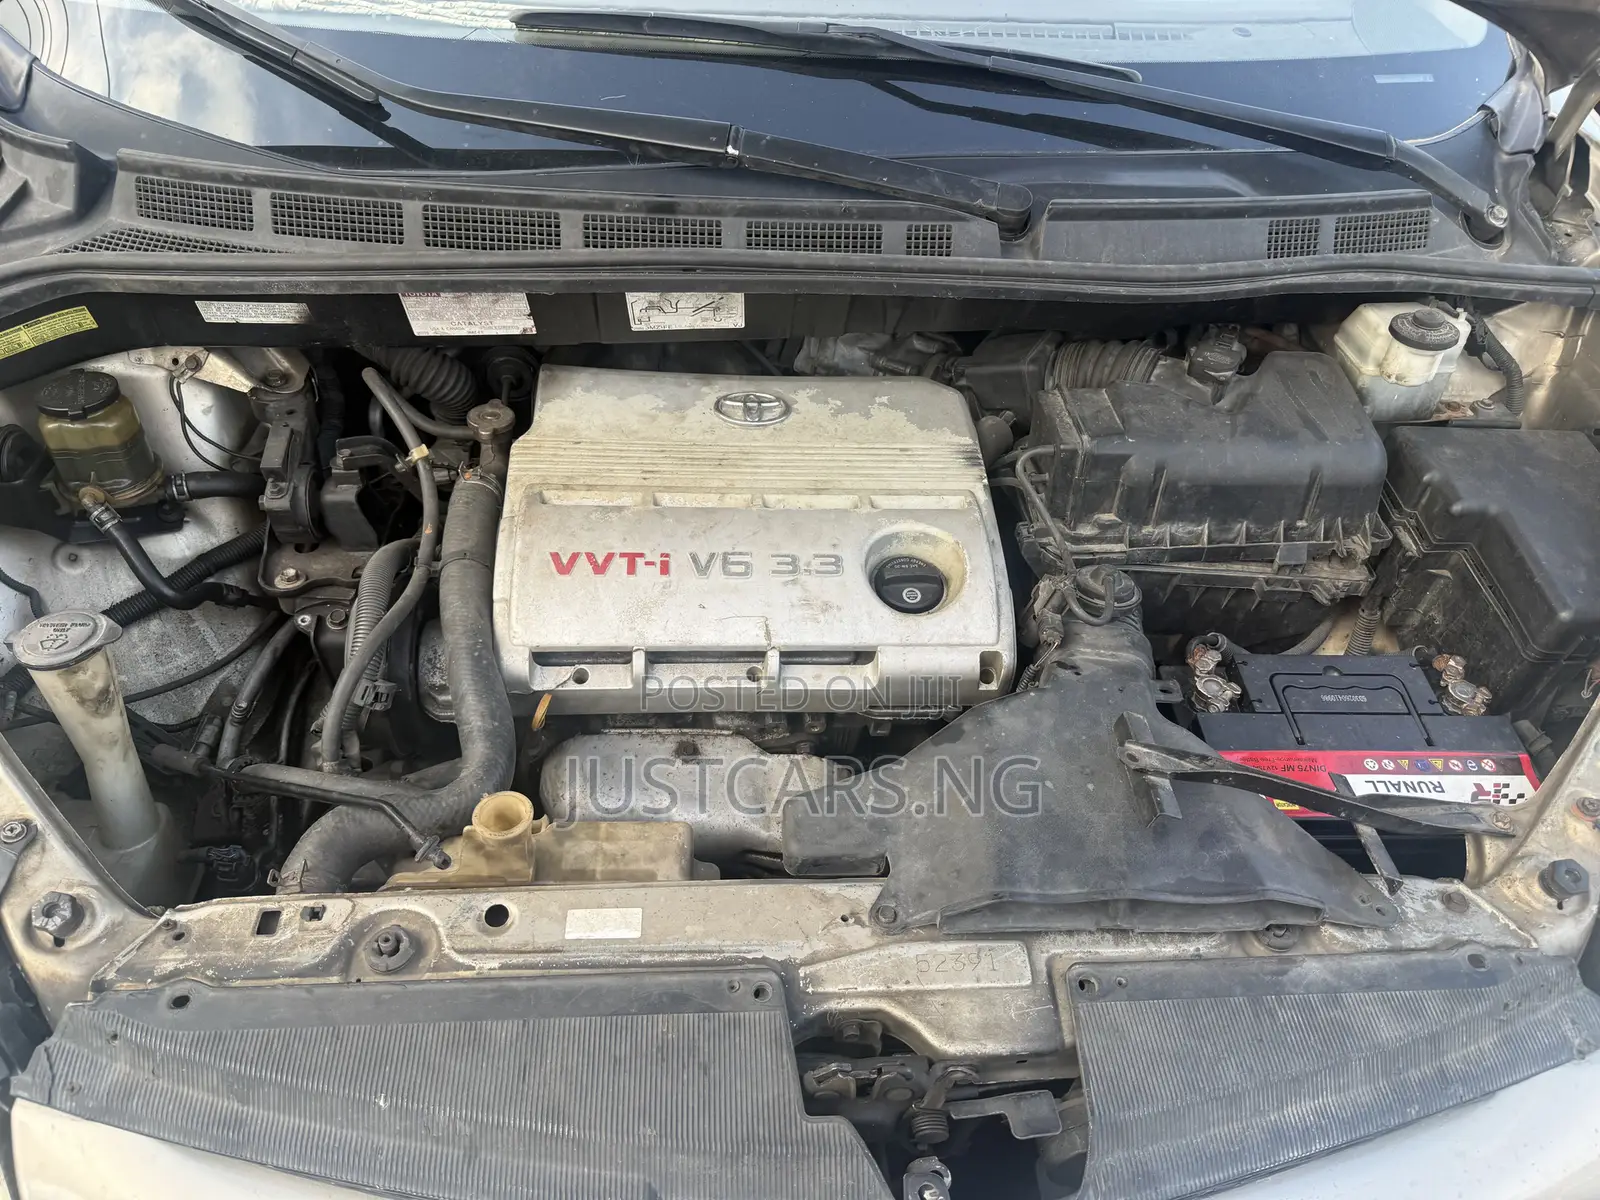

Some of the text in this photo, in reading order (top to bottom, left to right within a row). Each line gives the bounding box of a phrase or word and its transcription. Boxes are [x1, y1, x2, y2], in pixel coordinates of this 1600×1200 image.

[550, 551, 844, 578] VVT-i V6 3.3
[1280, 764, 1295, 772] MF
[1298, 764, 1327, 773] DIN75
[1364, 780, 1446, 793] RUNALL
[915, 953, 998, 973] 52391
